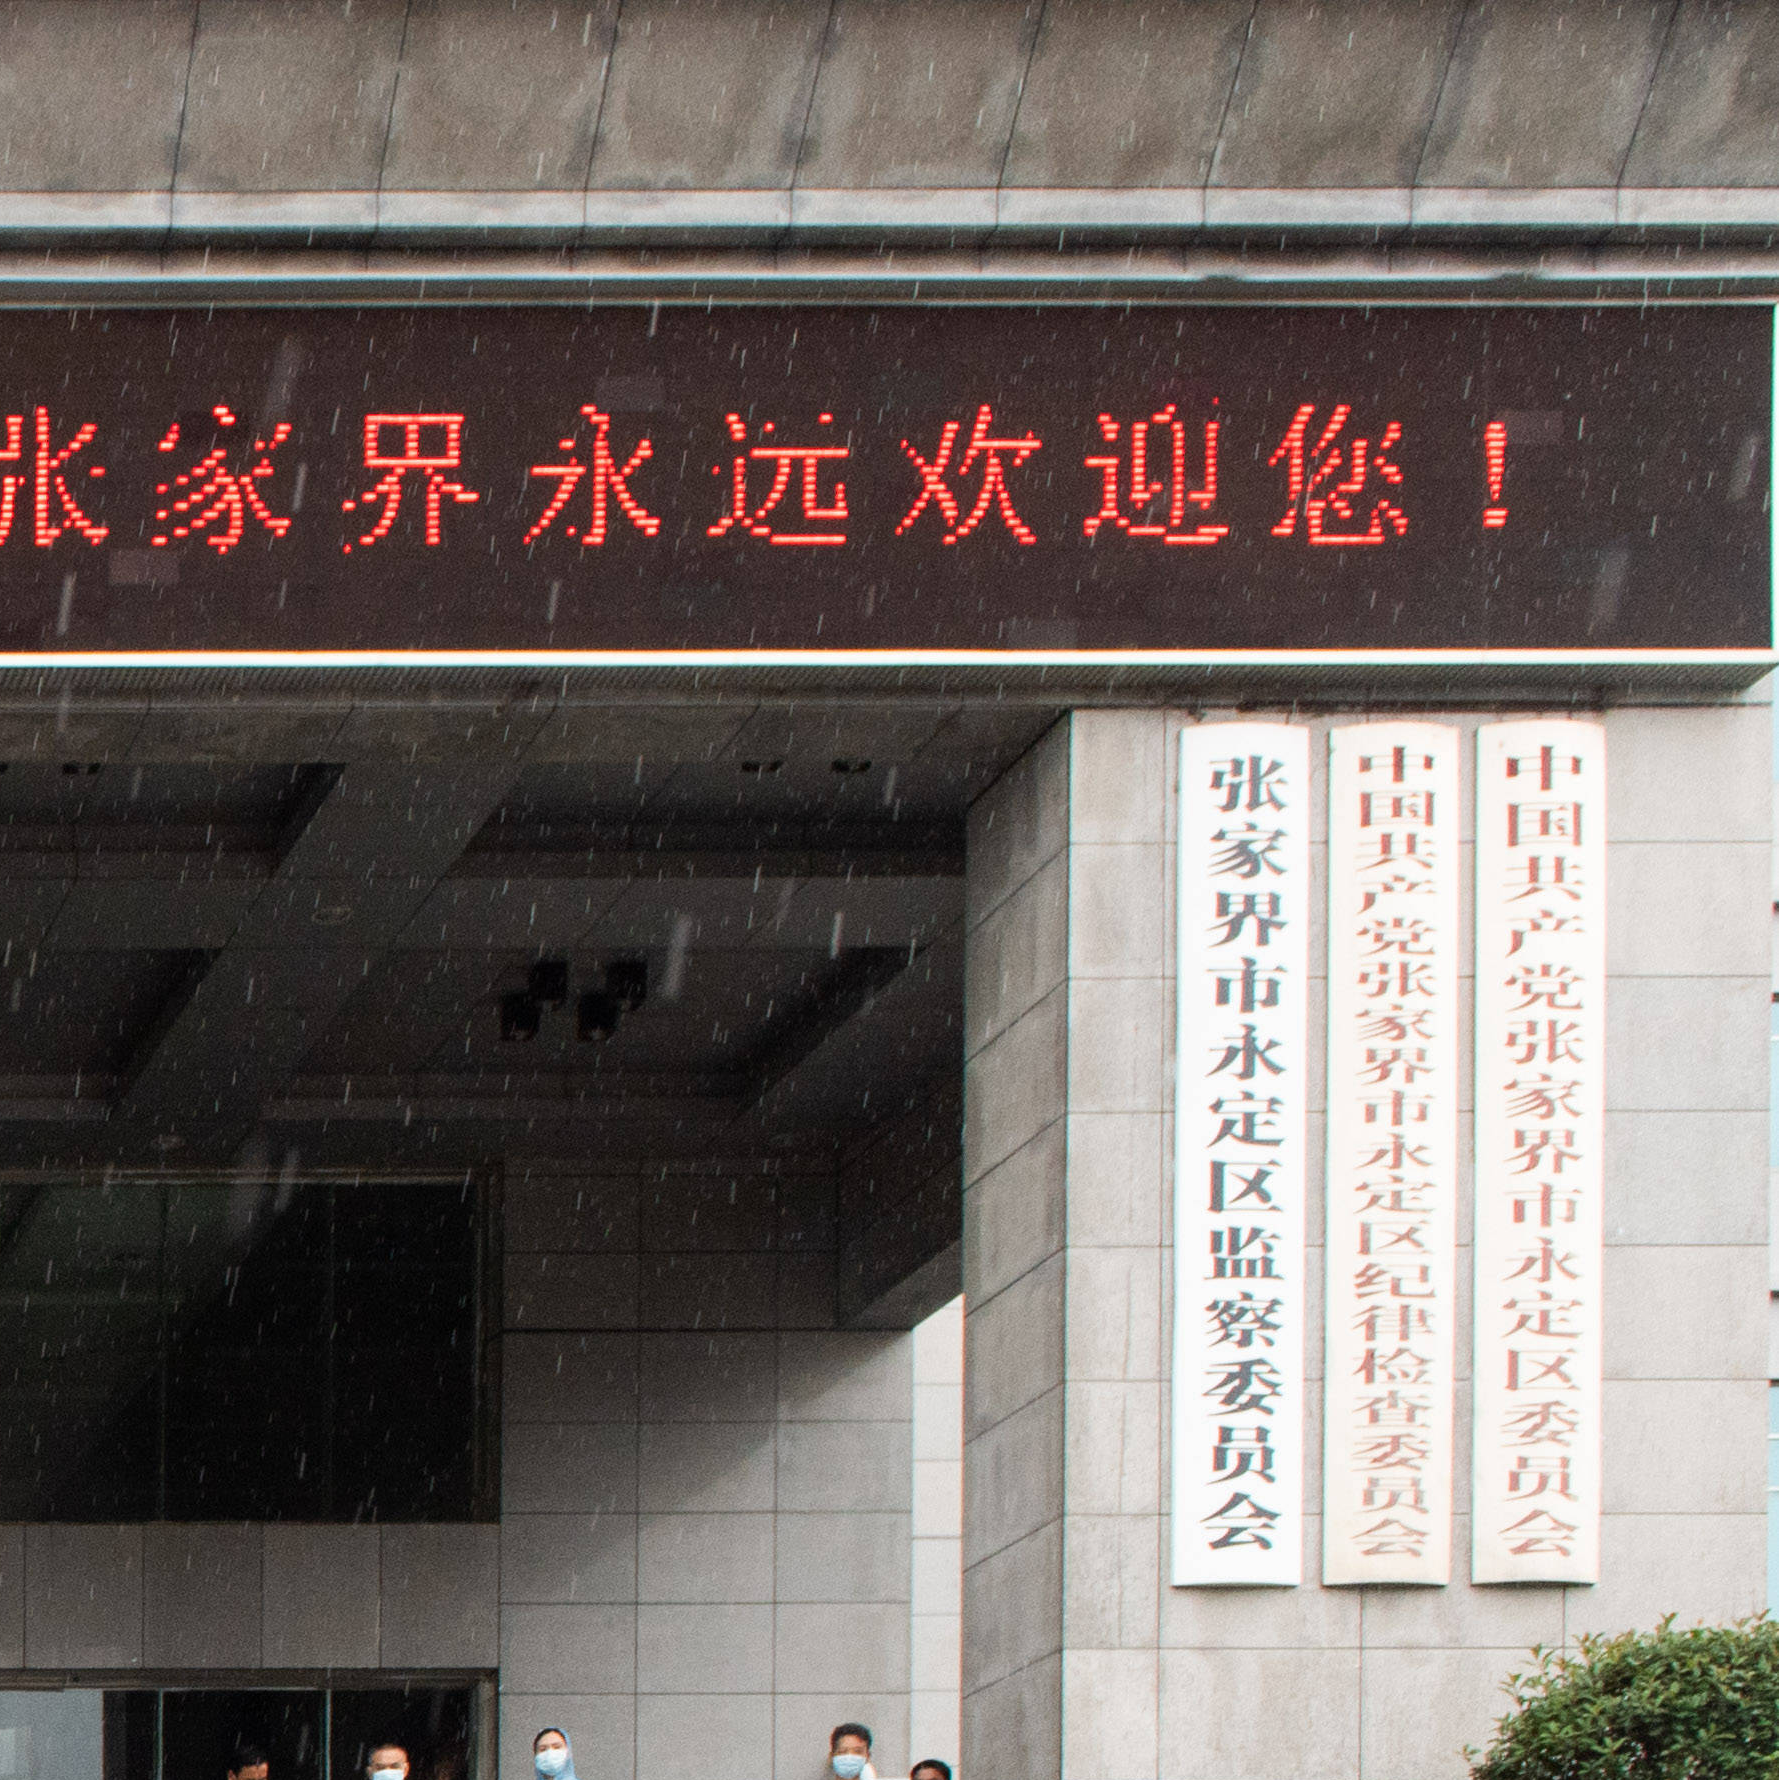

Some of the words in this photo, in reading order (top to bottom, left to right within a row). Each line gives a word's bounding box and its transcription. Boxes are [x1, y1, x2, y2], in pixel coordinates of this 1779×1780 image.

[1199, 754, 1290, 1553] 张家界市永定区监察委员会
[1350, 744, 1438, 1559] 中国共产党张家界市永定区纪律检查委员会
[1498, 744, 1587, 1559] 中国共产党张家界市永定区委员会
